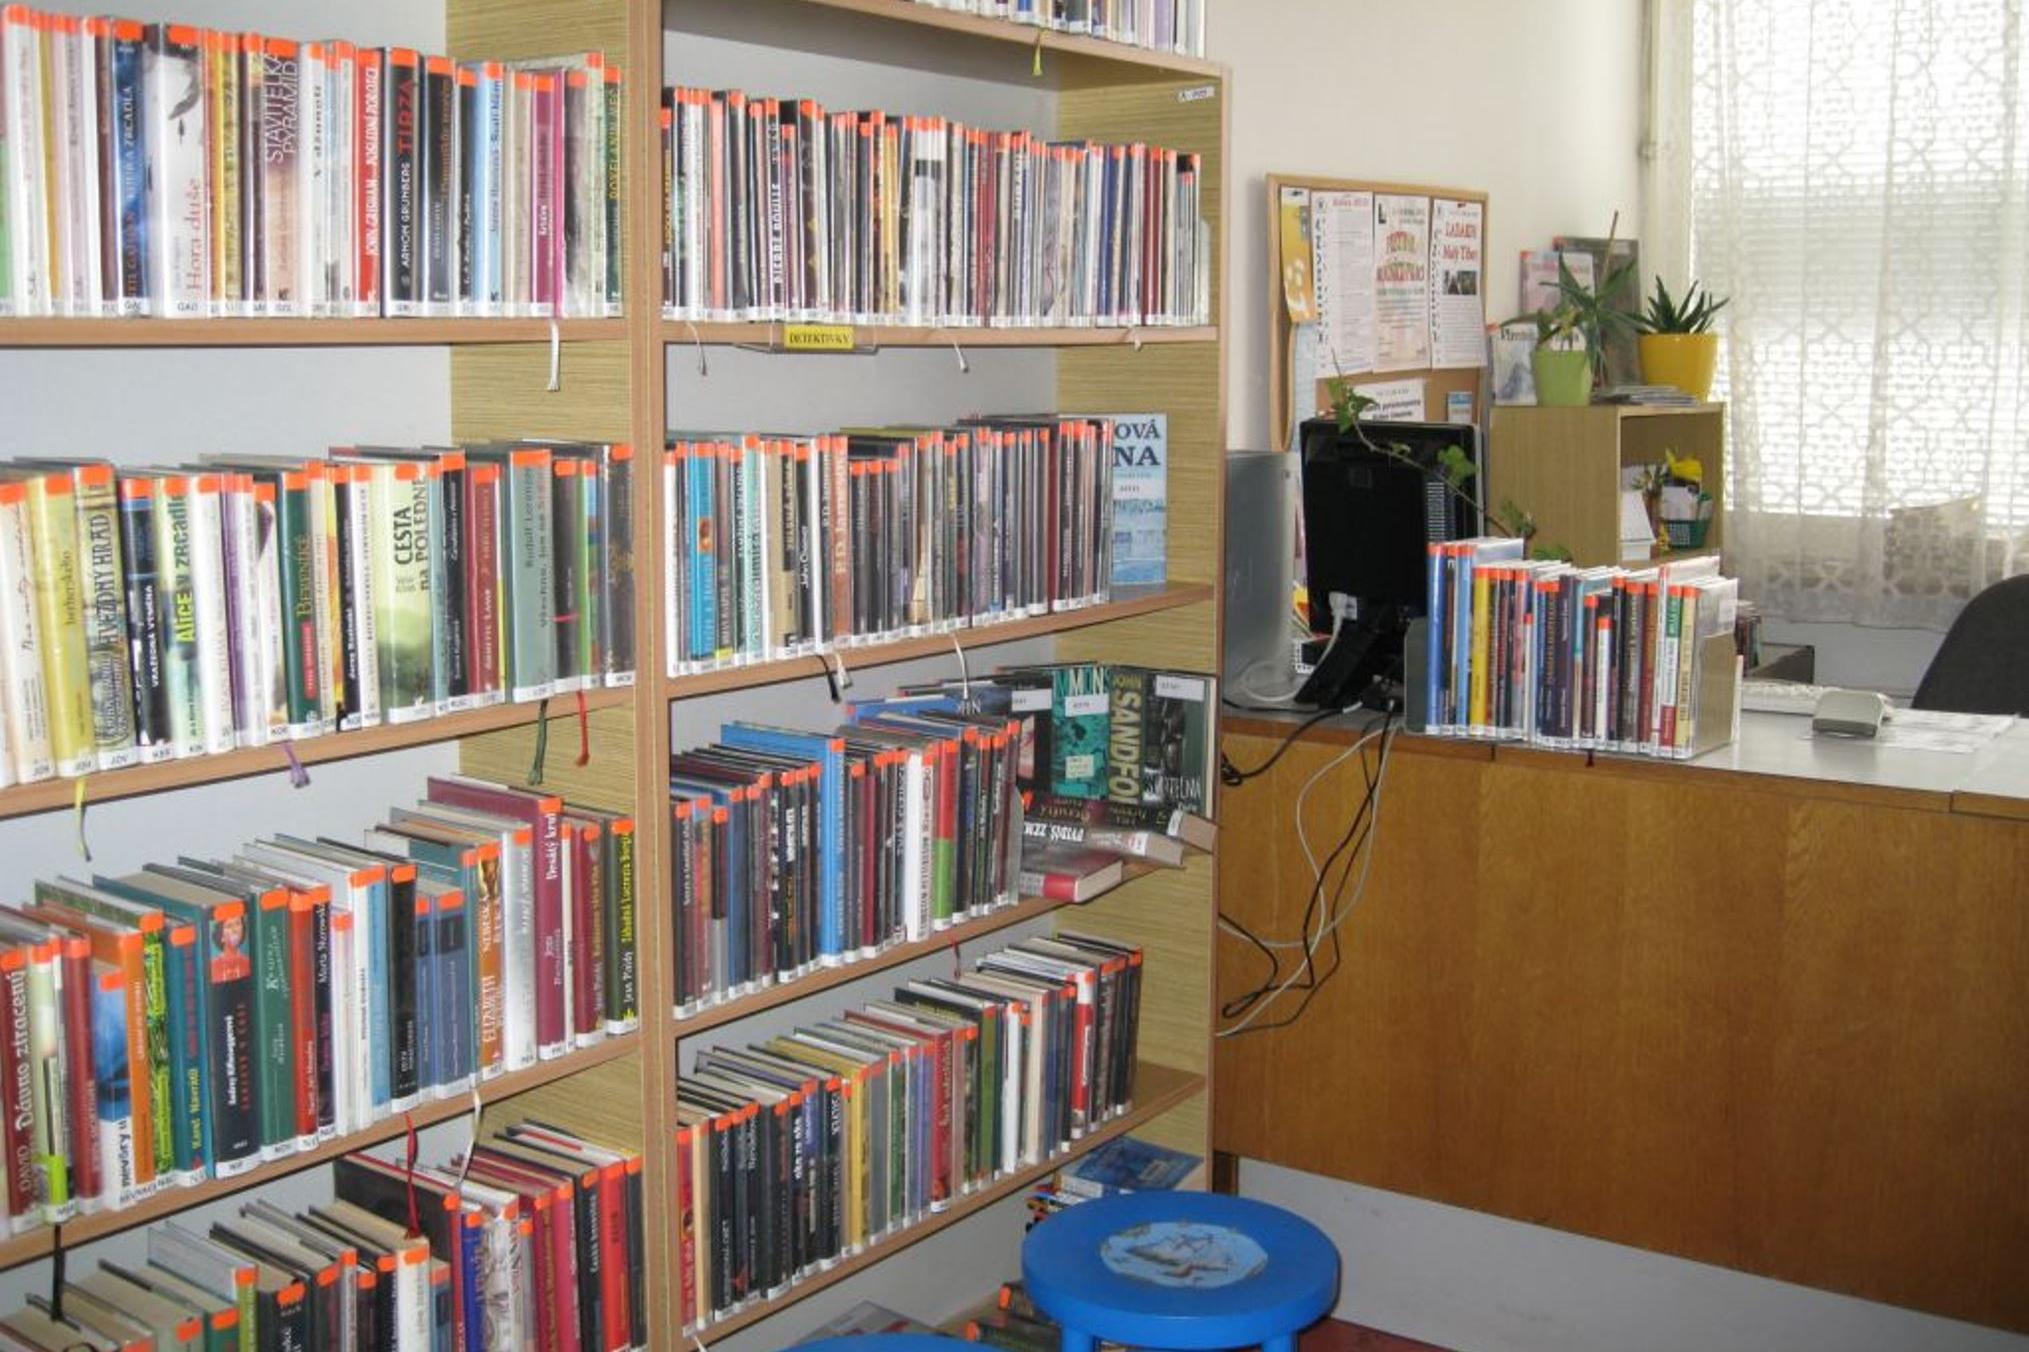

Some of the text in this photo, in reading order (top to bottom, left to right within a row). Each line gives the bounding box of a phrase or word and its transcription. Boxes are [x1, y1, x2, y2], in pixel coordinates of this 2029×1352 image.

[123, 86, 134, 147] ZRCADLA
[264, 52, 281, 162] STAVITELKA
[281, 62, 298, 153] PYRAMID
[397, 79, 414, 155] TIRZA
[184, 178, 202, 290] Hora duše
[400, 224, 411, 268] ARNON
[89, 515, 110, 565] HRAD
[394, 507, 413, 565] CESTA
[419, 568, 430, 591] na
[317, 952, 328, 983] Marta
[5, 970, 35, 1131] Dávno ztracený
